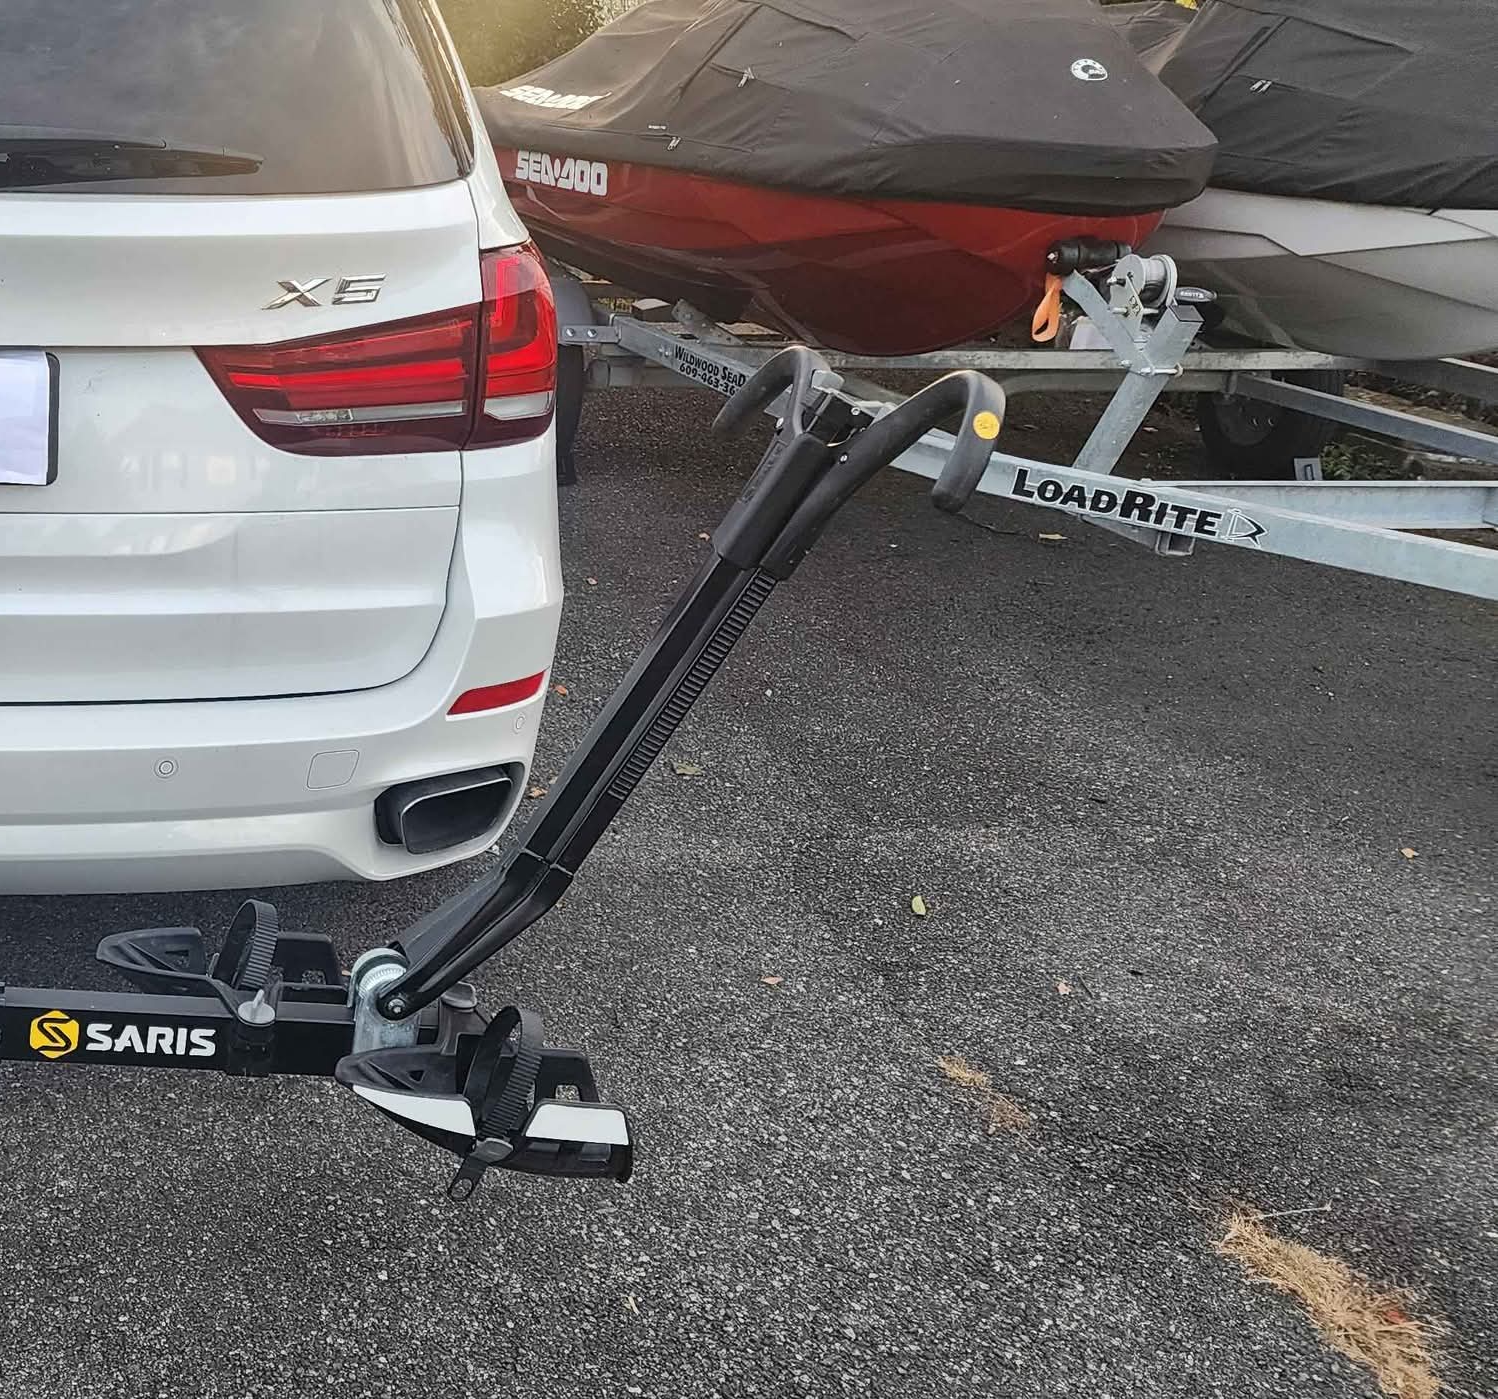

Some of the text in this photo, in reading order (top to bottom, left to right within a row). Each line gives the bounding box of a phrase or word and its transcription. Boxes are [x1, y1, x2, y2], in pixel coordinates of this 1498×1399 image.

[261, 273, 387, 310] X5
[675, 344, 720, 377] WILDWOOD
[679, 363, 739, 397] 609-463-36
[1011, 467, 1224, 537] LOADRITE
[86, 1023, 216, 1057] SARIS
